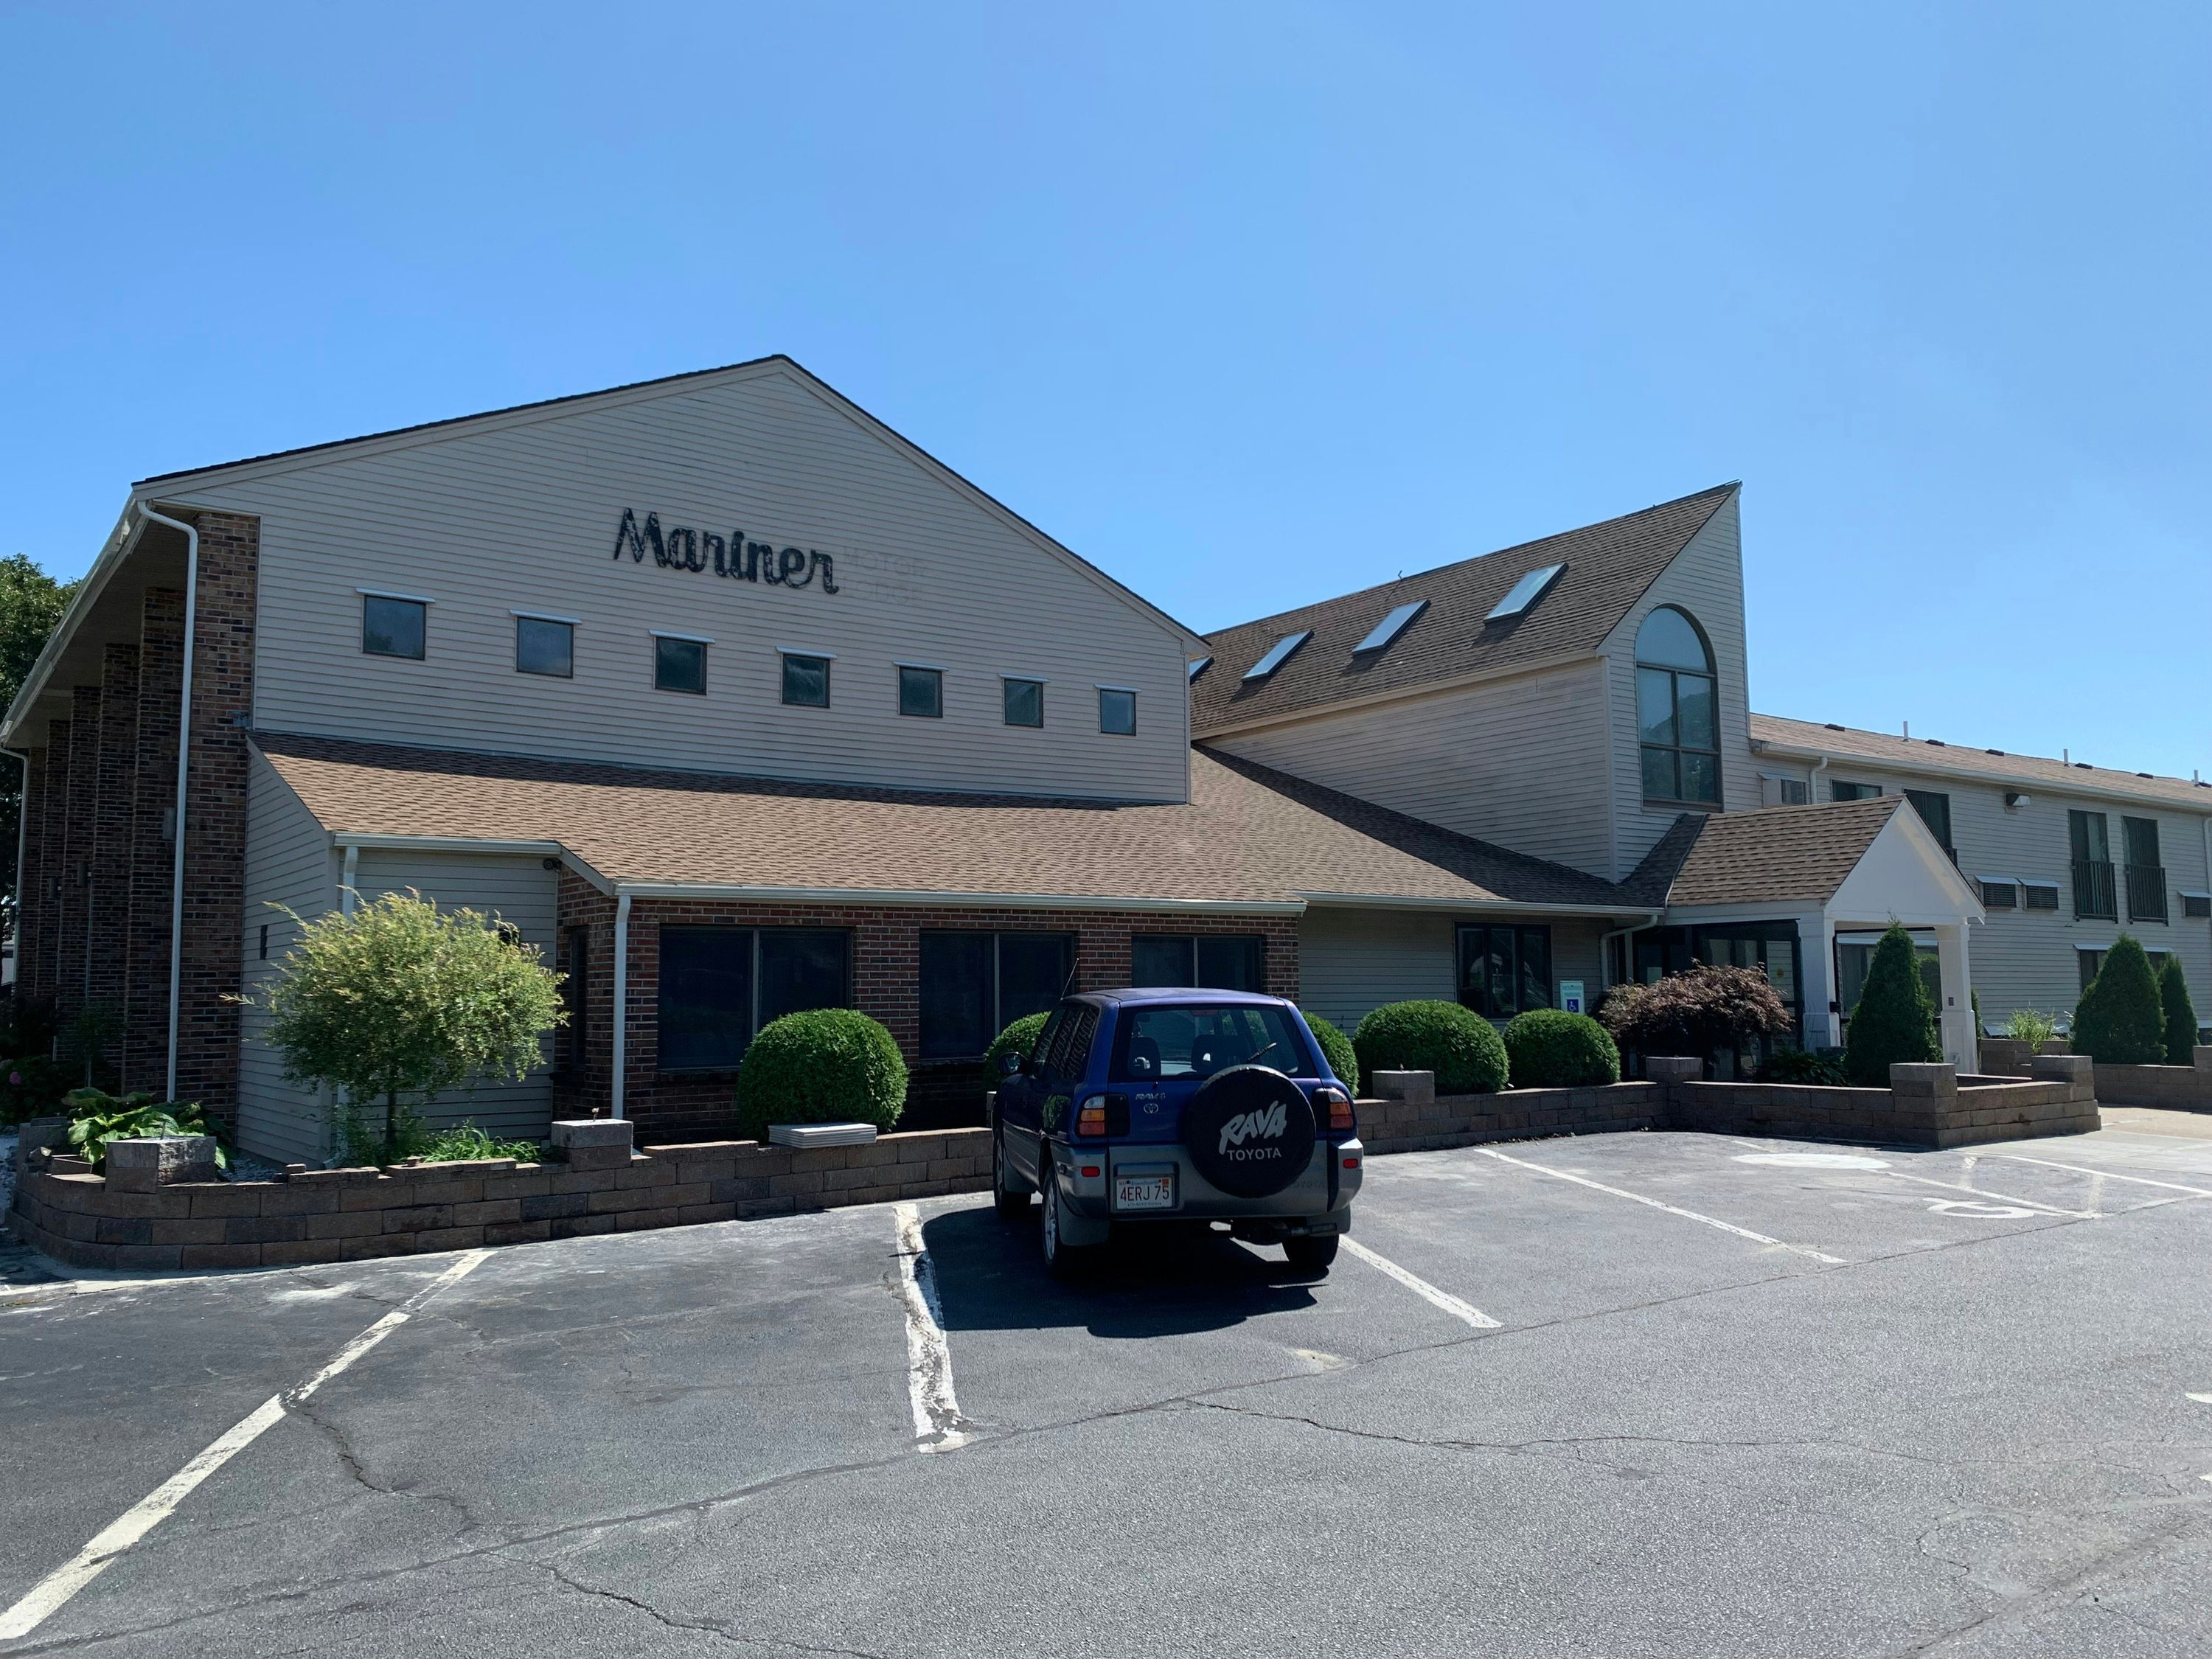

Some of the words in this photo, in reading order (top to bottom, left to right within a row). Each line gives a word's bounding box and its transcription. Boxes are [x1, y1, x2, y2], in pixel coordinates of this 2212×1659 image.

[613, 507, 839, 595] Mariner
[1227, 1147, 1281, 1161] TOYOTA
[1120, 1185, 1150, 1202] 4ERJ
[1155, 1185, 1169, 1200] 75
